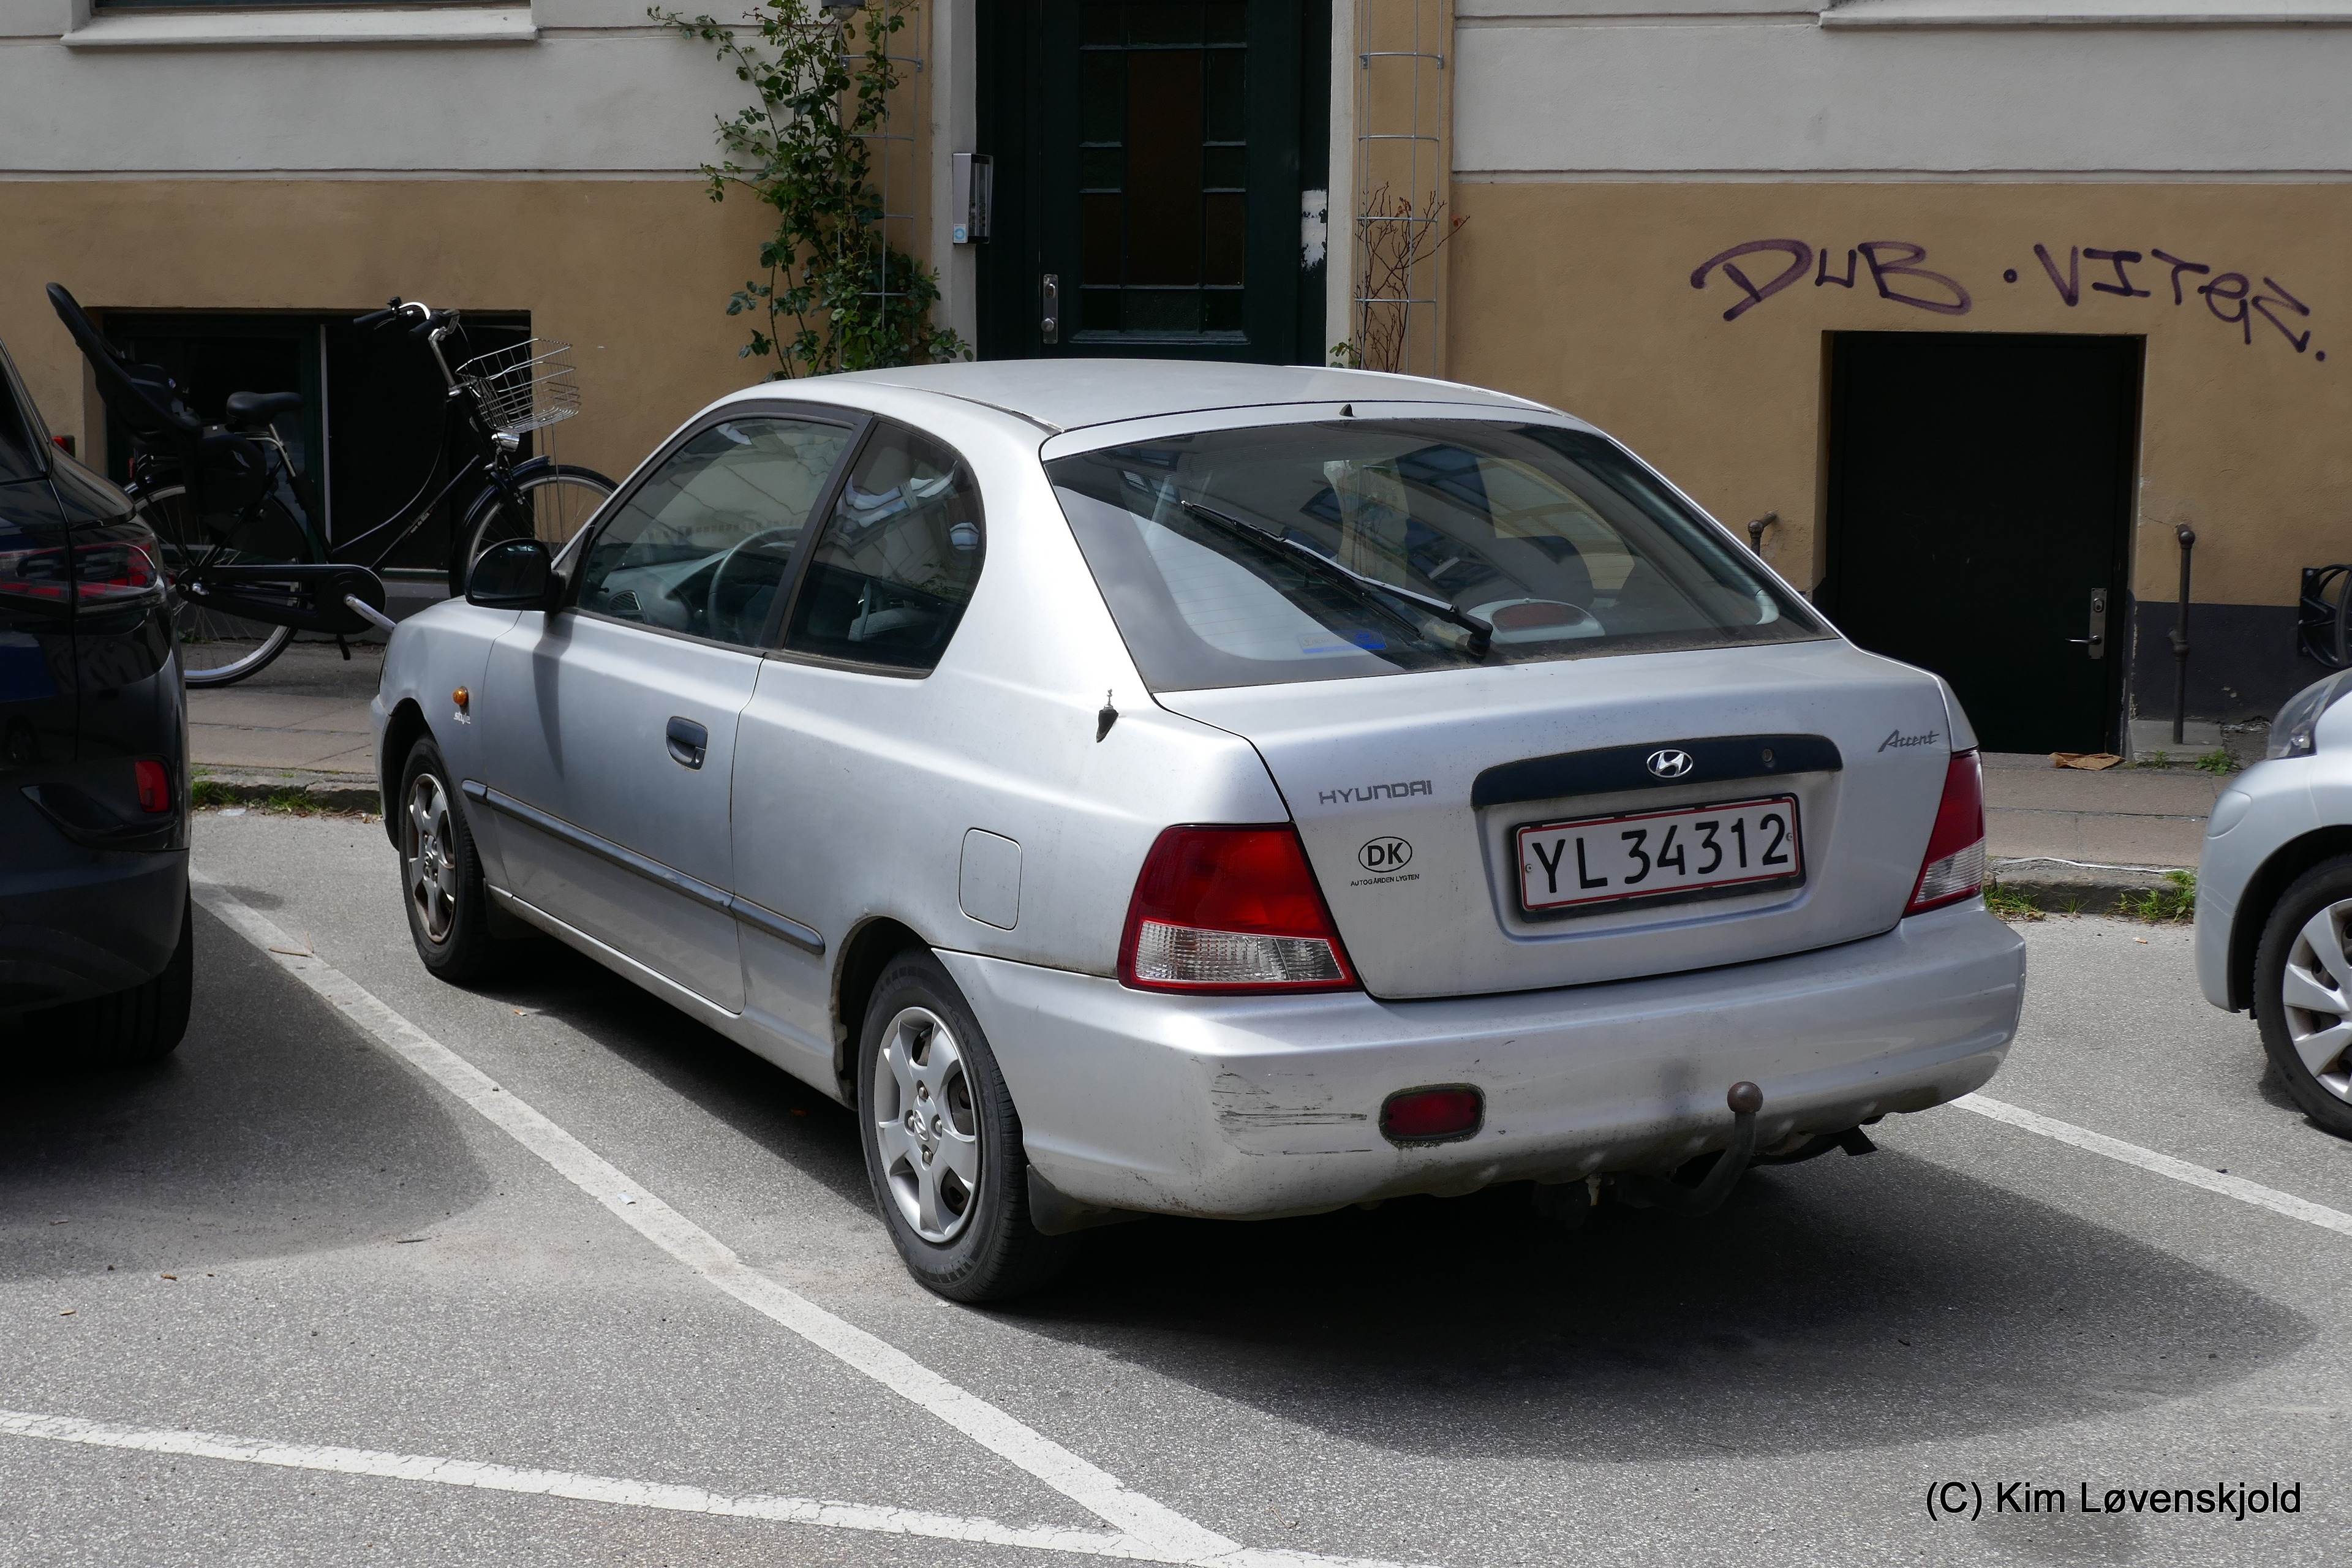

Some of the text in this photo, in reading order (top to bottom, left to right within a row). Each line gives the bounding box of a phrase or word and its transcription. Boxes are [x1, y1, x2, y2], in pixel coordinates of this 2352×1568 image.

[453, 711, 471, 725] style
[1877, 729, 1940, 753] Accent
[1318, 780, 1433, 804] HYUNDAI
[1367, 842, 1404, 867] DK
[1531, 813, 1789, 894] YL 34312
[1351, 873, 1420, 887] AUTOGÅRDEN LYGTEN
